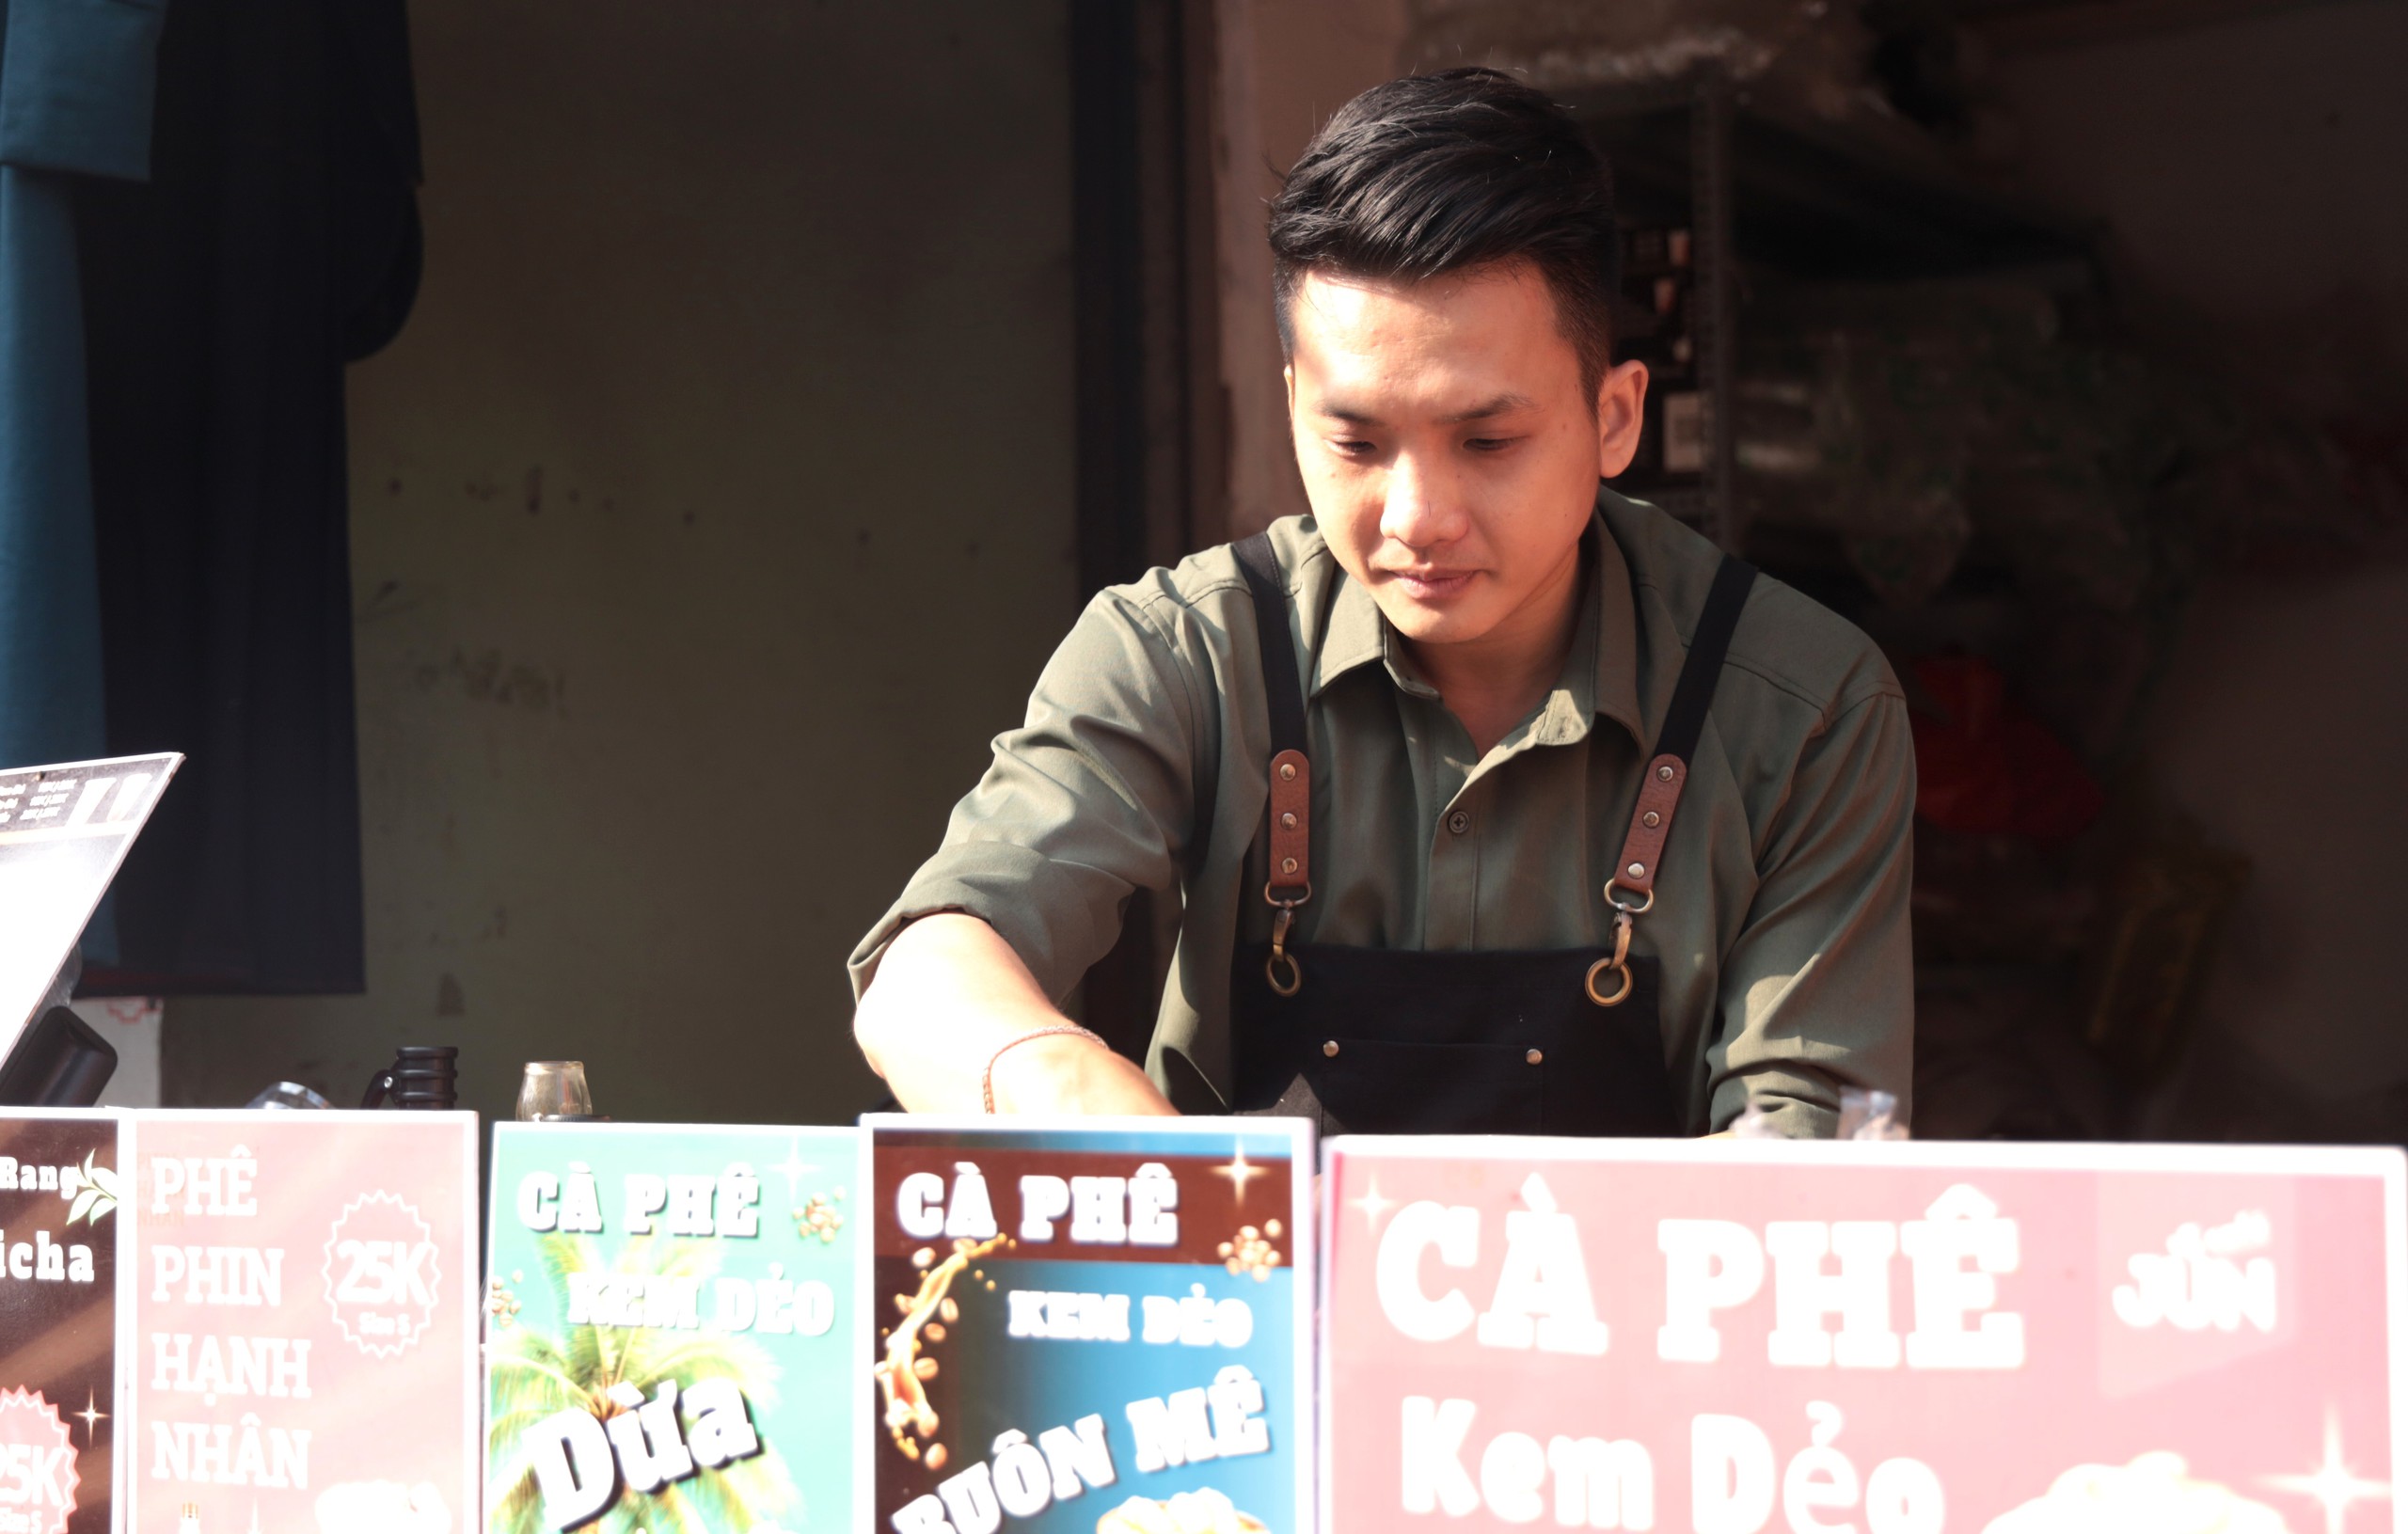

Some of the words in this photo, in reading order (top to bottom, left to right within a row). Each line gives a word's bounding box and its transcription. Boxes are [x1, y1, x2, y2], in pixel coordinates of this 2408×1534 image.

[151, 1144, 258, 1217] PHÊ
[517, 1161, 604, 1234] CÀ
[624, 1162, 761, 1239] PHÊ
[897, 1162, 997, 1238] CÀ
[1021, 1162, 1178, 1244] PHÊ
[151, 1244, 285, 1307] PHIN
[336, 1240, 432, 1306] 25K
[567, 1273, 699, 1329] KEM
[715, 1262, 834, 1336] DẺO
[1376, 1173, 1609, 1355] CÀ
[1657, 1183, 2023, 1368] PHÊ
[1008, 1290, 1131, 1341] KEM
[1142, 1283, 1253, 1348] DẺO
[151, 1332, 312, 1407] HẠNH
[151, 1412, 312, 1491] NHÂN
[521, 1379, 762, 1534] Dừa
[1126, 1365, 1270, 1473] MÊ
[1402, 1397, 1654, 1531] Kem
[1691, 1400, 1944, 1534] Dẻo
